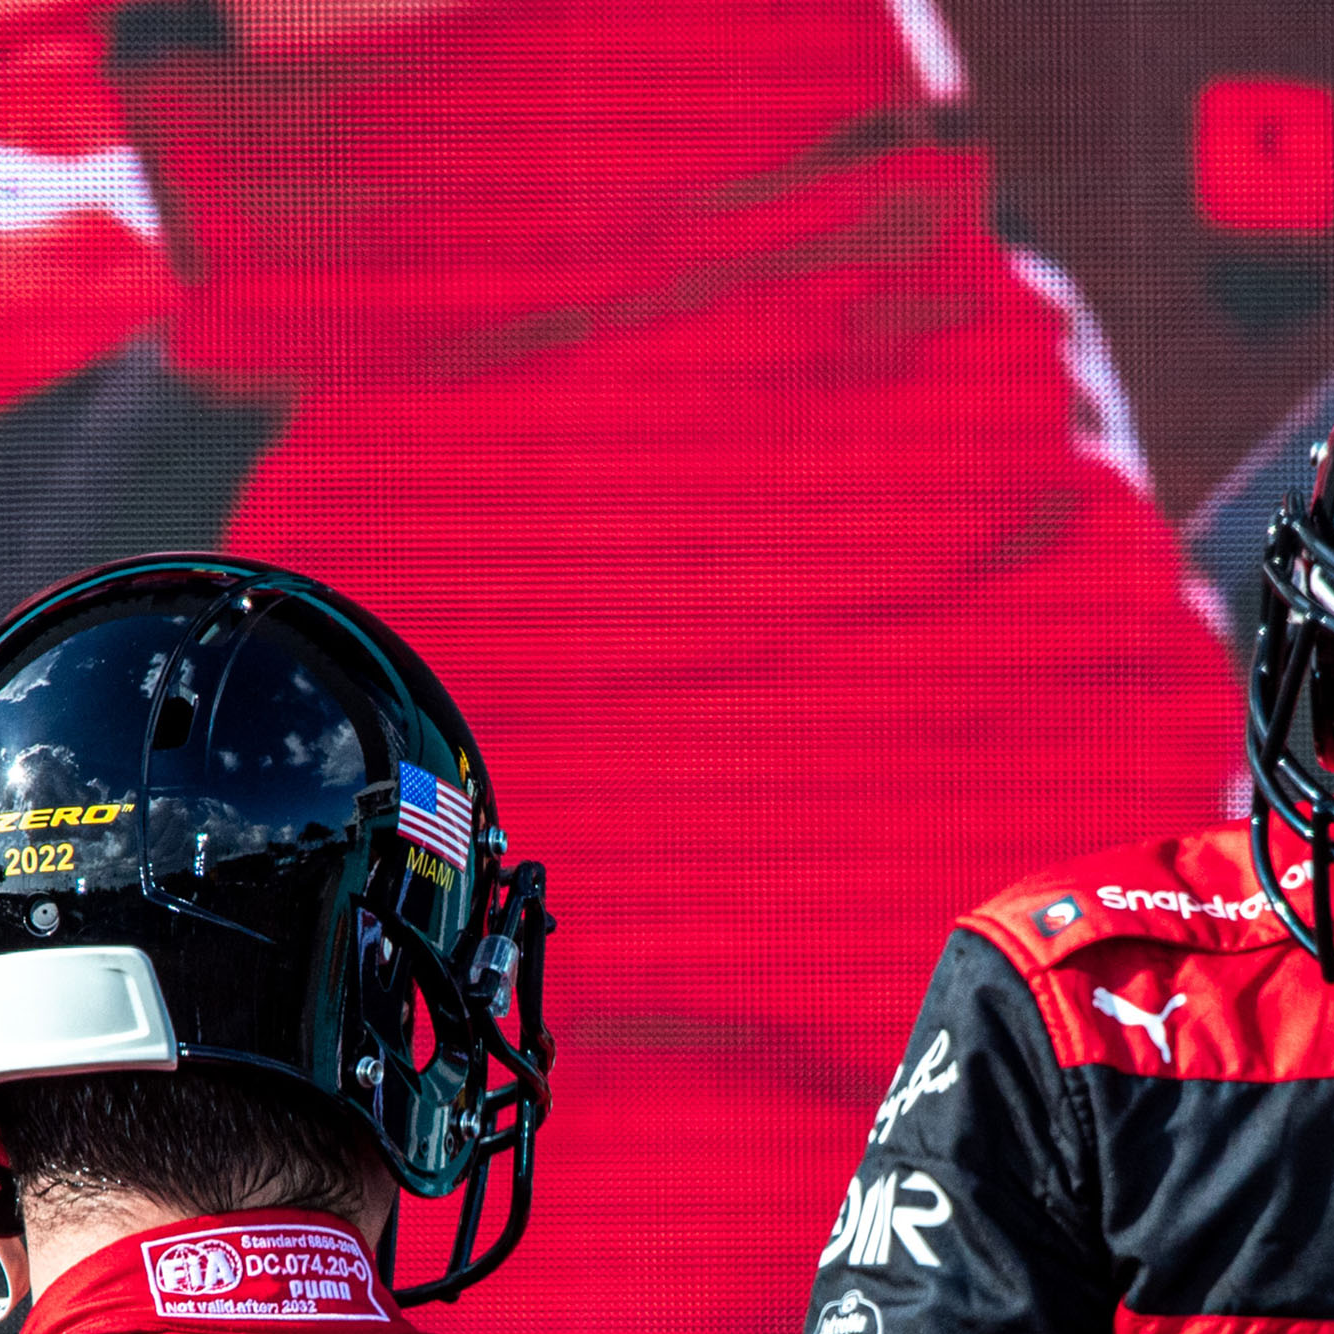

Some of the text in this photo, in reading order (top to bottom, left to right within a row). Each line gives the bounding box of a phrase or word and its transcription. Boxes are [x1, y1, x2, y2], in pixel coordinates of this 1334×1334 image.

[4, 842, 75, 877] 2022
[405, 846, 455, 892] MIAMI
[240, 1233, 307, 1250] Standard
[165, 1299, 197, 1314] Not
[197, 1298, 235, 1314] valid
[281, 1299, 317, 1314] 2032
